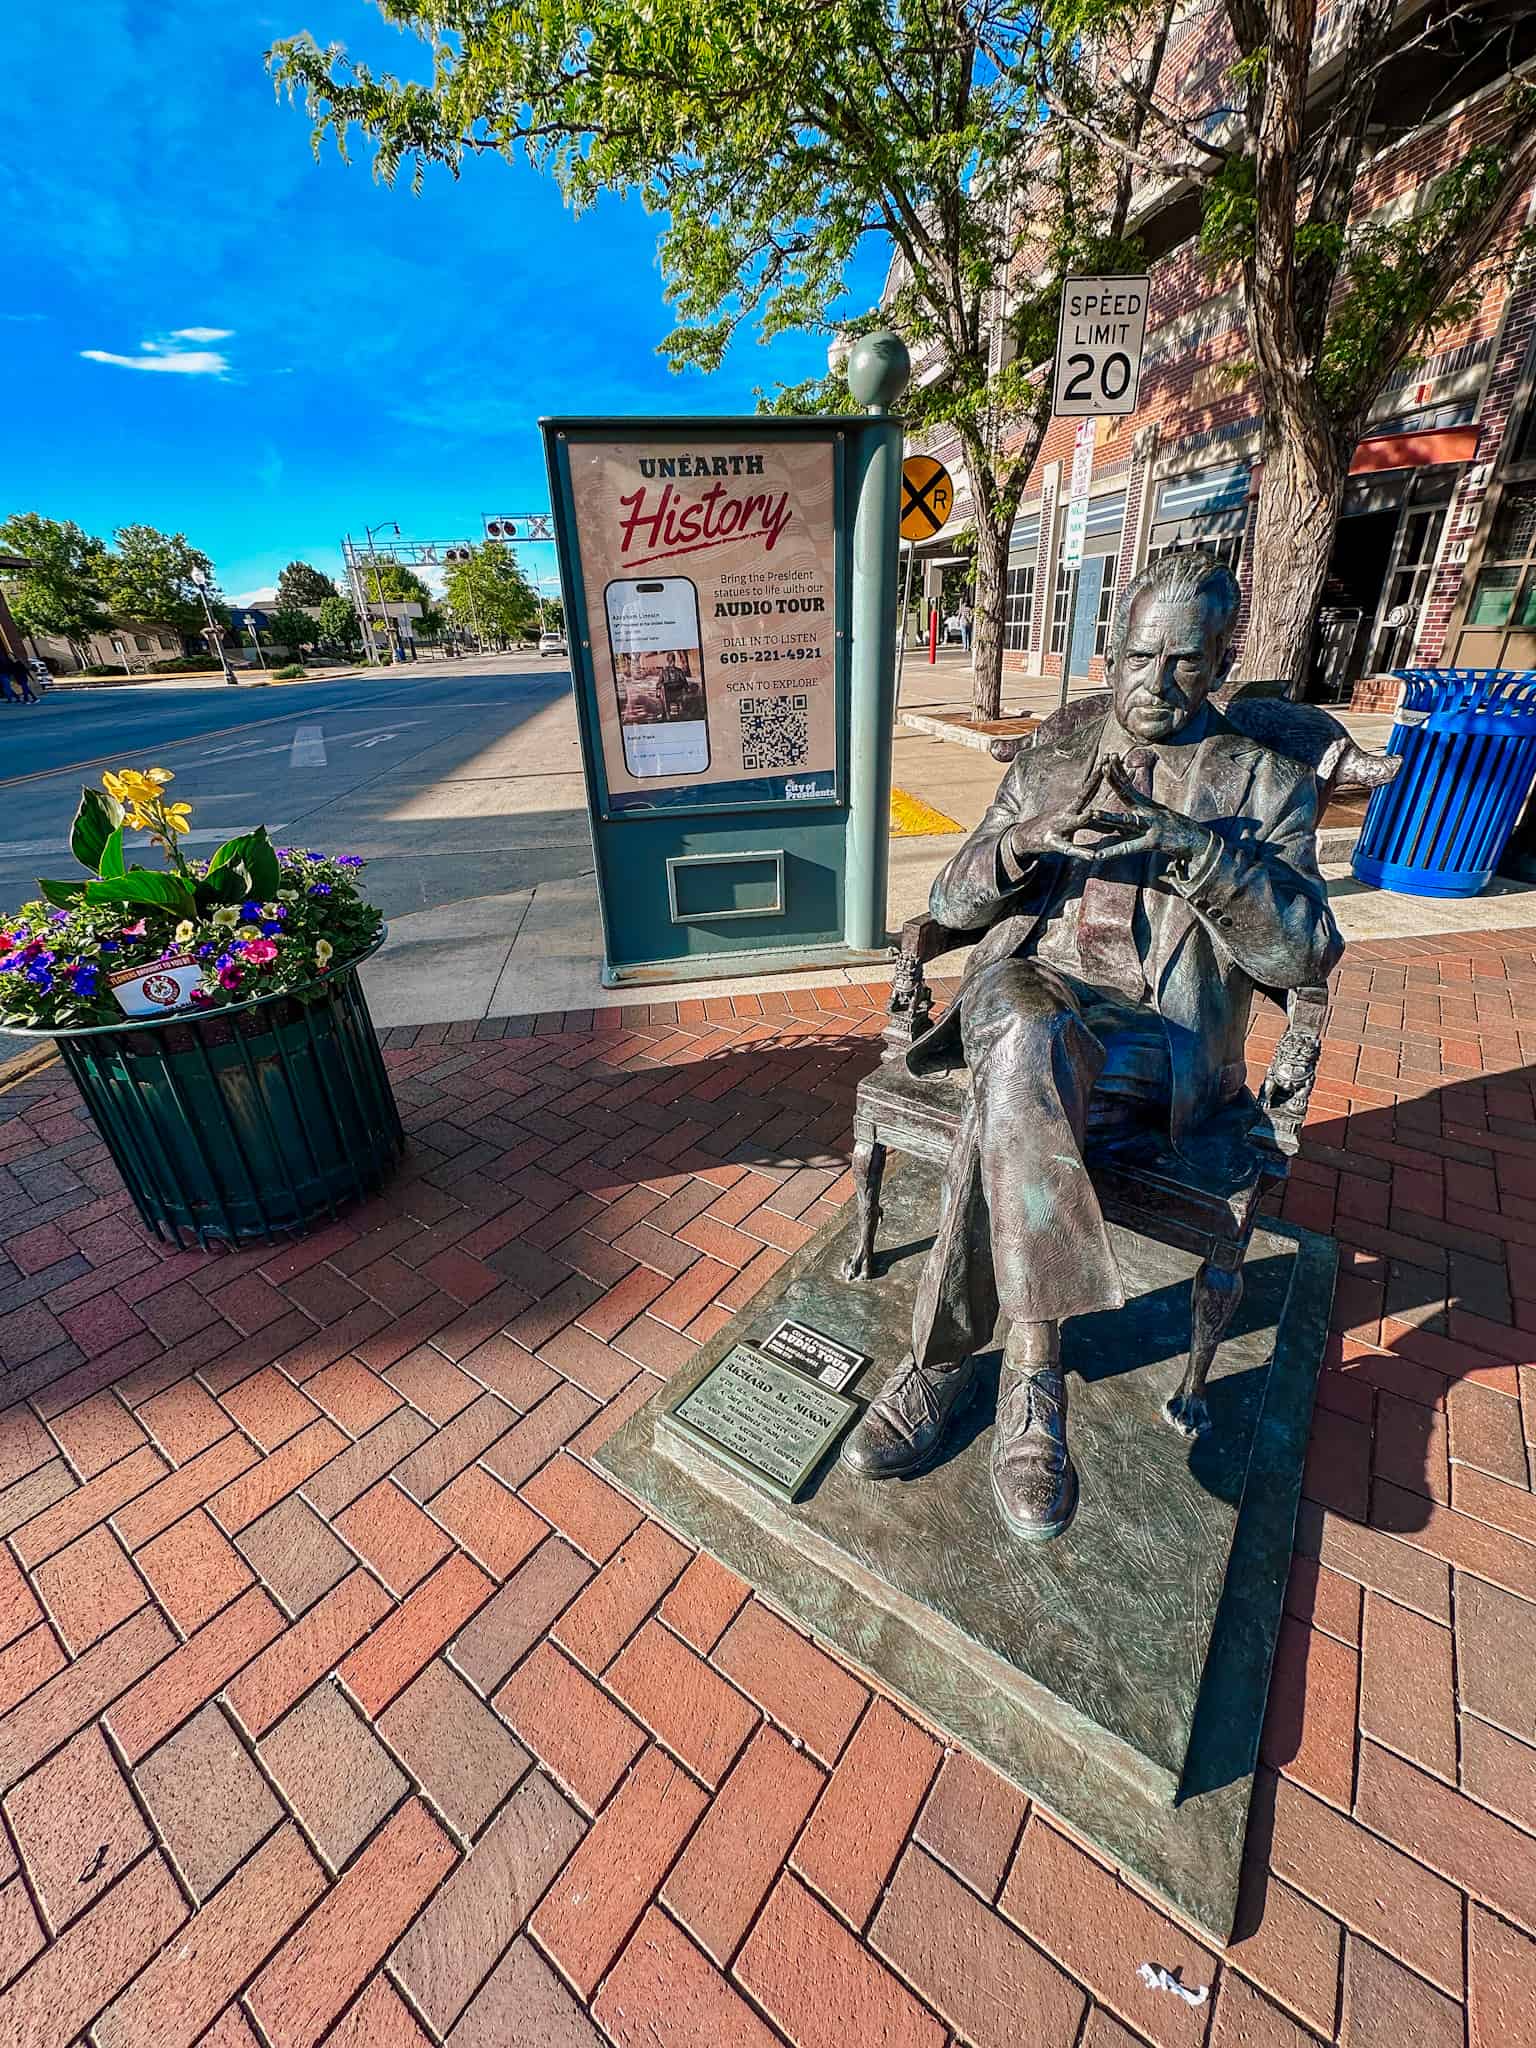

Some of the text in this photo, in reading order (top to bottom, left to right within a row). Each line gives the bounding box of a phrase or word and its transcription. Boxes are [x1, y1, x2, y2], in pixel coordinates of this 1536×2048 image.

[1070, 294, 1141, 316] SPEED
[1075, 324, 1130, 345] LIMIT
[1063, 351, 1131, 401] 20
[638, 455, 765, 478] UNEARTH
[933, 488, 947, 509] R
[619, 481, 793, 552] History
[720, 569, 813, 586] Bring the President
[713, 583, 824, 598] statues to life with our
[714, 597, 825, 617] AUDIO TOUR
[723, 633, 817, 648] DIAL IN TO LISTEN
[719, 647, 822, 664] 605-221-4921
[726, 677, 819, 693] SCAN TO EXPLORE
[785, 783, 805, 793] City
[805, 781, 816, 791] of
[785, 788, 836, 800] Presidents
[778, 1330, 817, 1354] AUDIO
[817, 1349, 851, 1373] TOUR
[725, 1362, 773, 1394] RICHARD
[793, 1402, 832, 1429] NIXON
